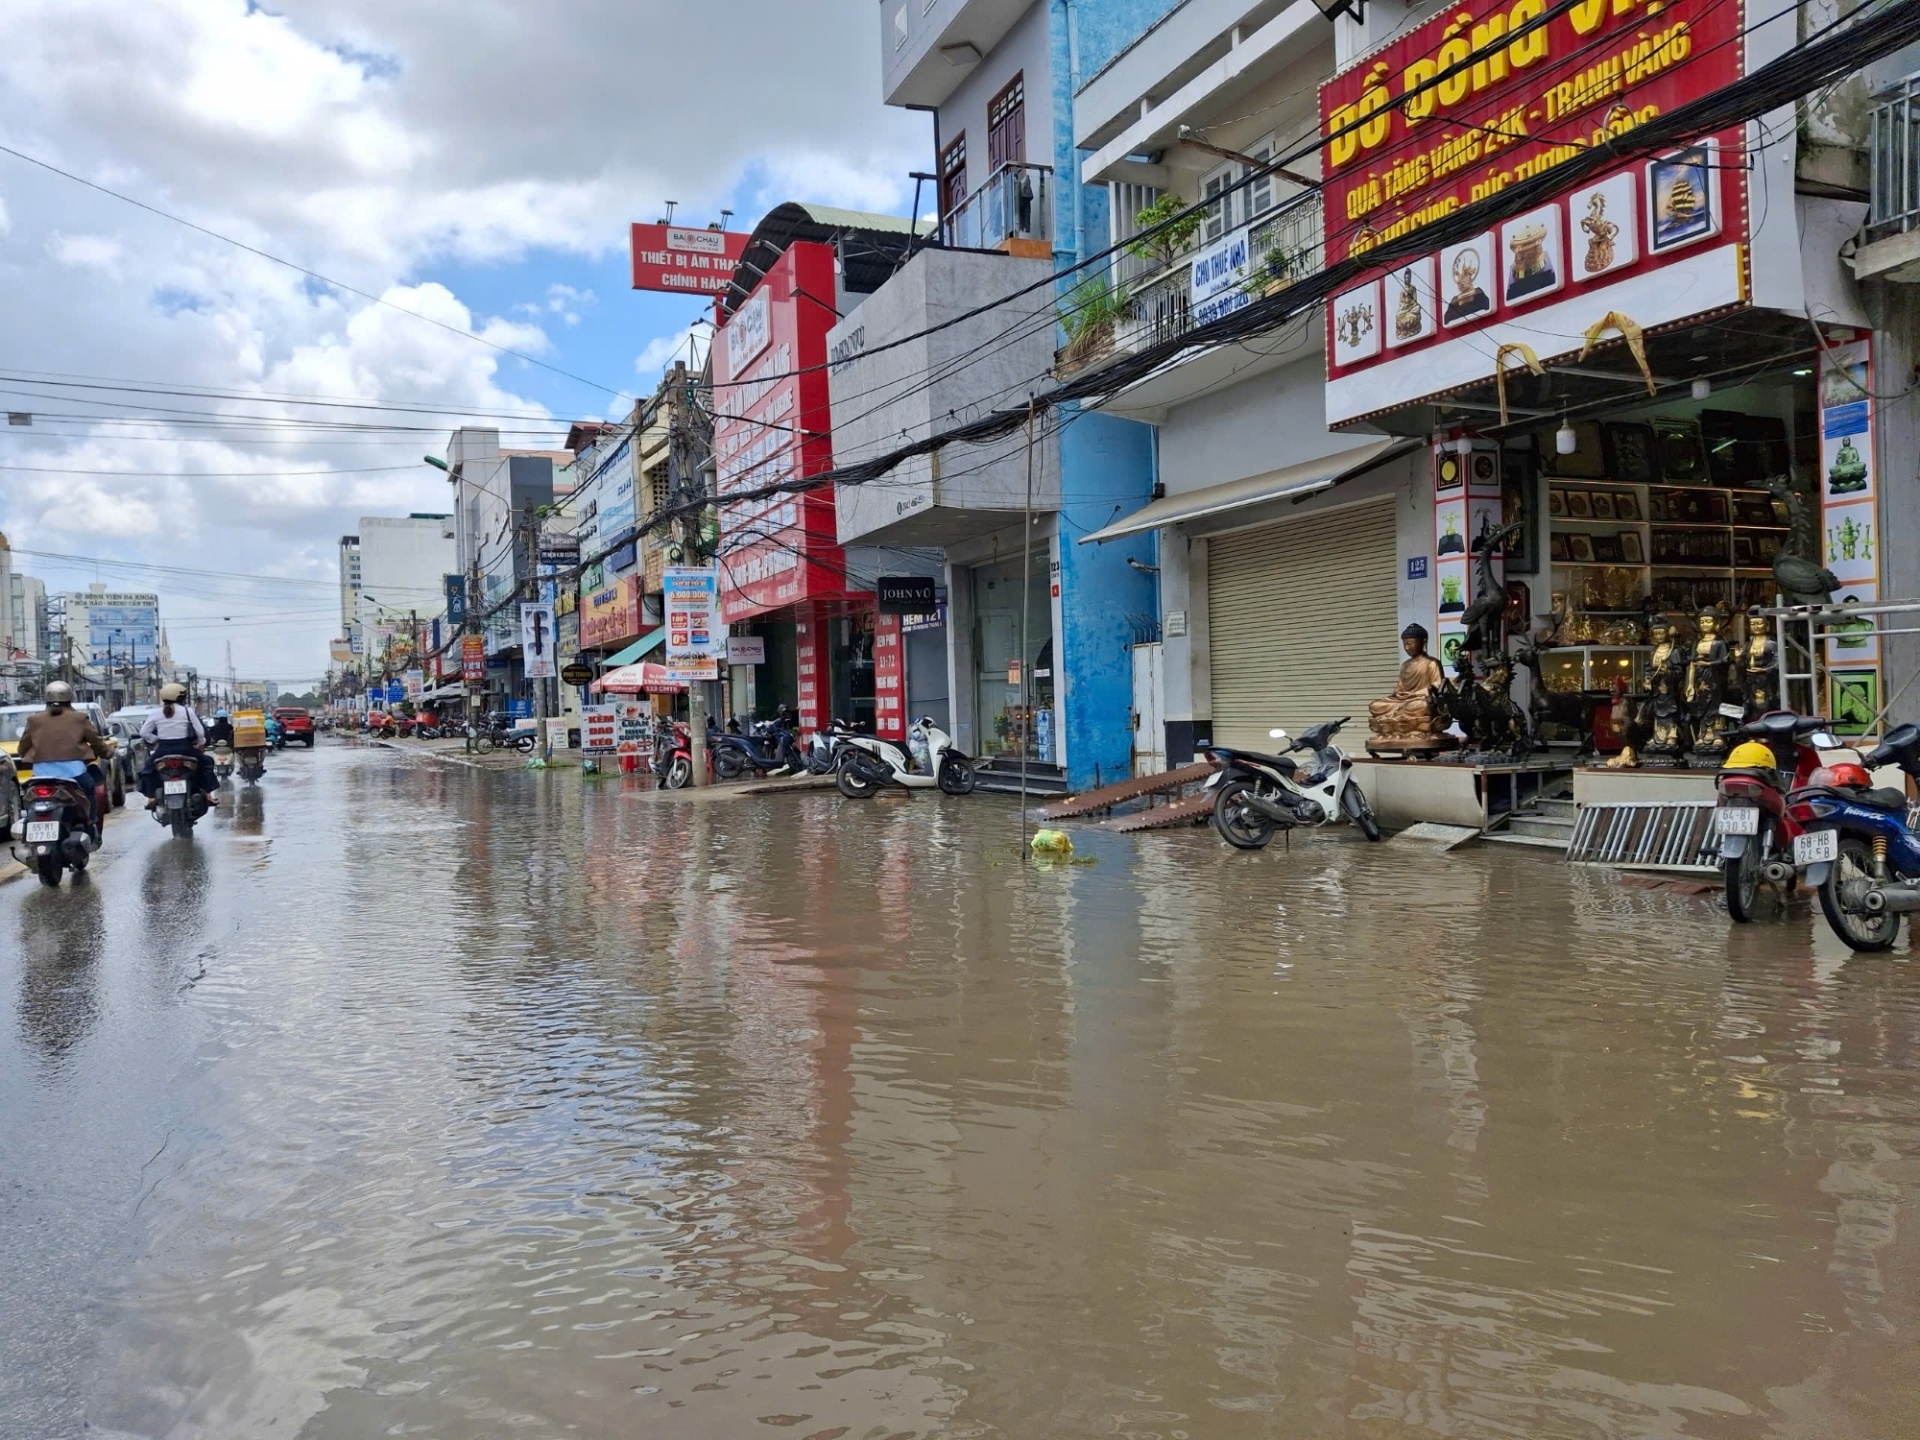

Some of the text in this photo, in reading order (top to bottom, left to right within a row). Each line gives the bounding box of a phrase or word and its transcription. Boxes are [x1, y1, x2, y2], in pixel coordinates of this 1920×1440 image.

[1346, 172, 1384, 220] QUÀ
[1483, 103, 1529, 154] 24K
[1543, 55, 1622, 123] TRANH
[1622, 21, 1691, 84] VÀNG
[641, 250, 672, 265] THIẾT
[676, 254, 687, 268] BỊ
[662, 273, 697, 288] CHÍNH
[1410, 559, 1425, 571] 125
[883, 588, 931, 600] JOHN VŨ
[589, 727, 613, 735] DAO
[1722, 808, 1750, 821] 64-B1
[1717, 821, 1754, 833] 330.51
[1800, 833, 1829, 849] 68-HB
